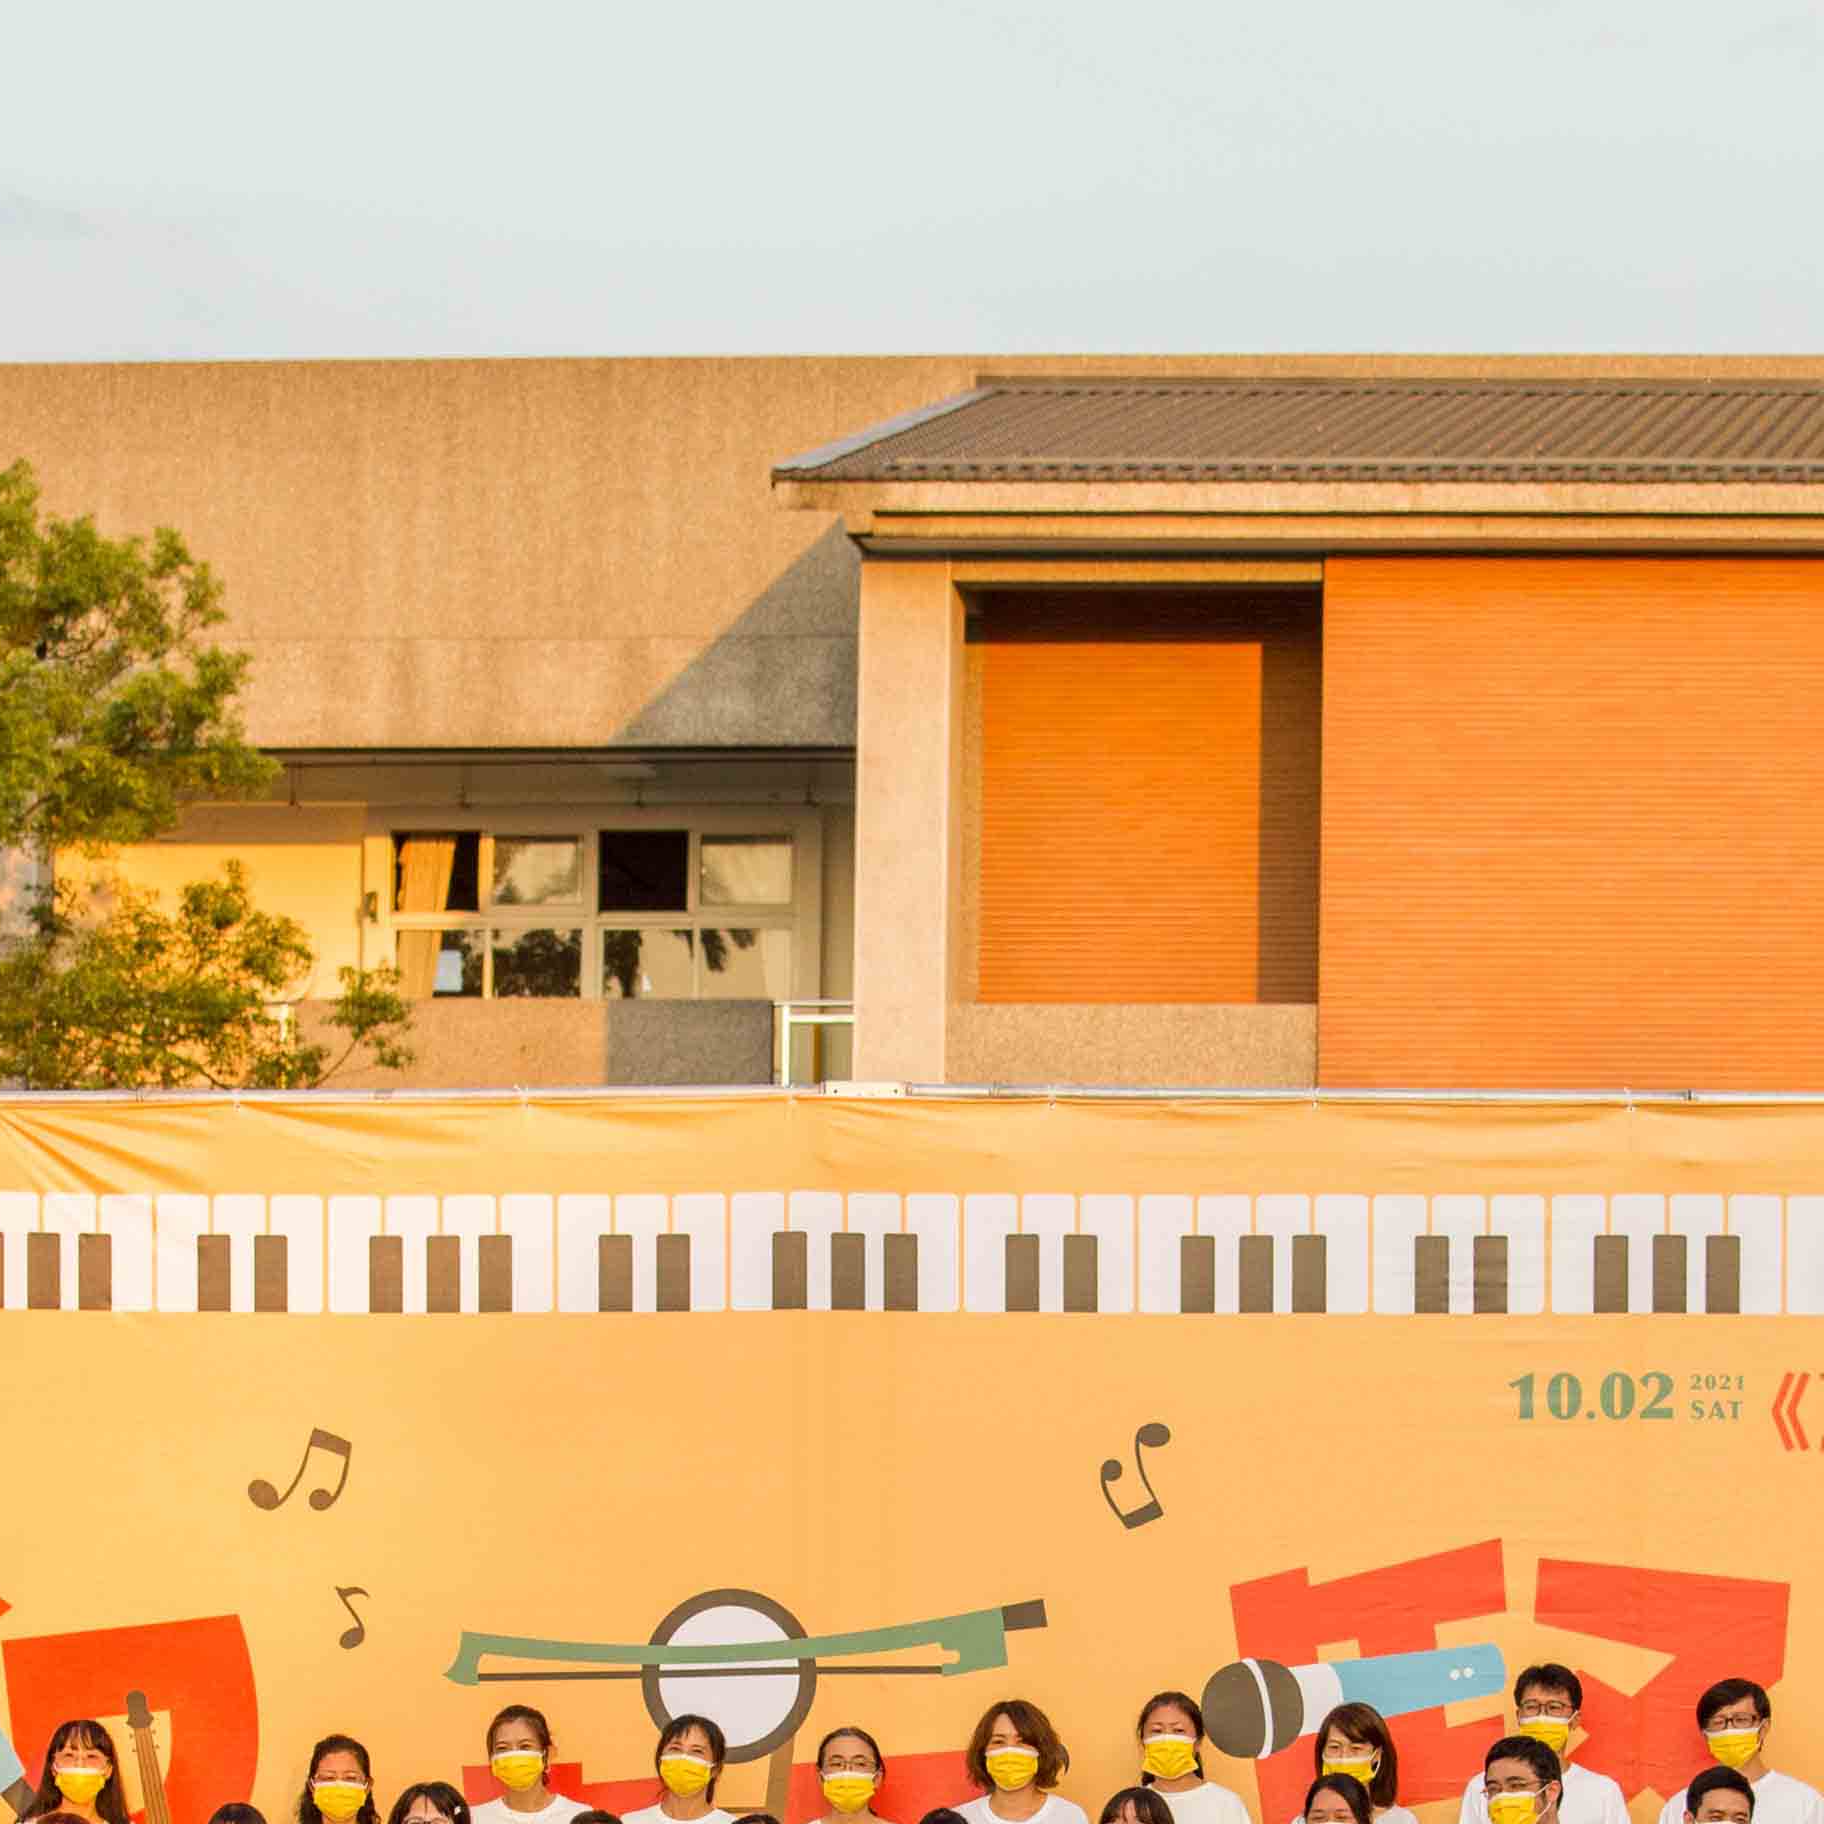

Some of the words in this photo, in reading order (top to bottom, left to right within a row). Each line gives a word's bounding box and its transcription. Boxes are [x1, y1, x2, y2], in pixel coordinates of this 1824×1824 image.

[1507, 1371, 1675, 1421] 10.02
[1690, 1374, 1744, 1391] 2021
[1690, 1401, 1744, 1420] SAT
